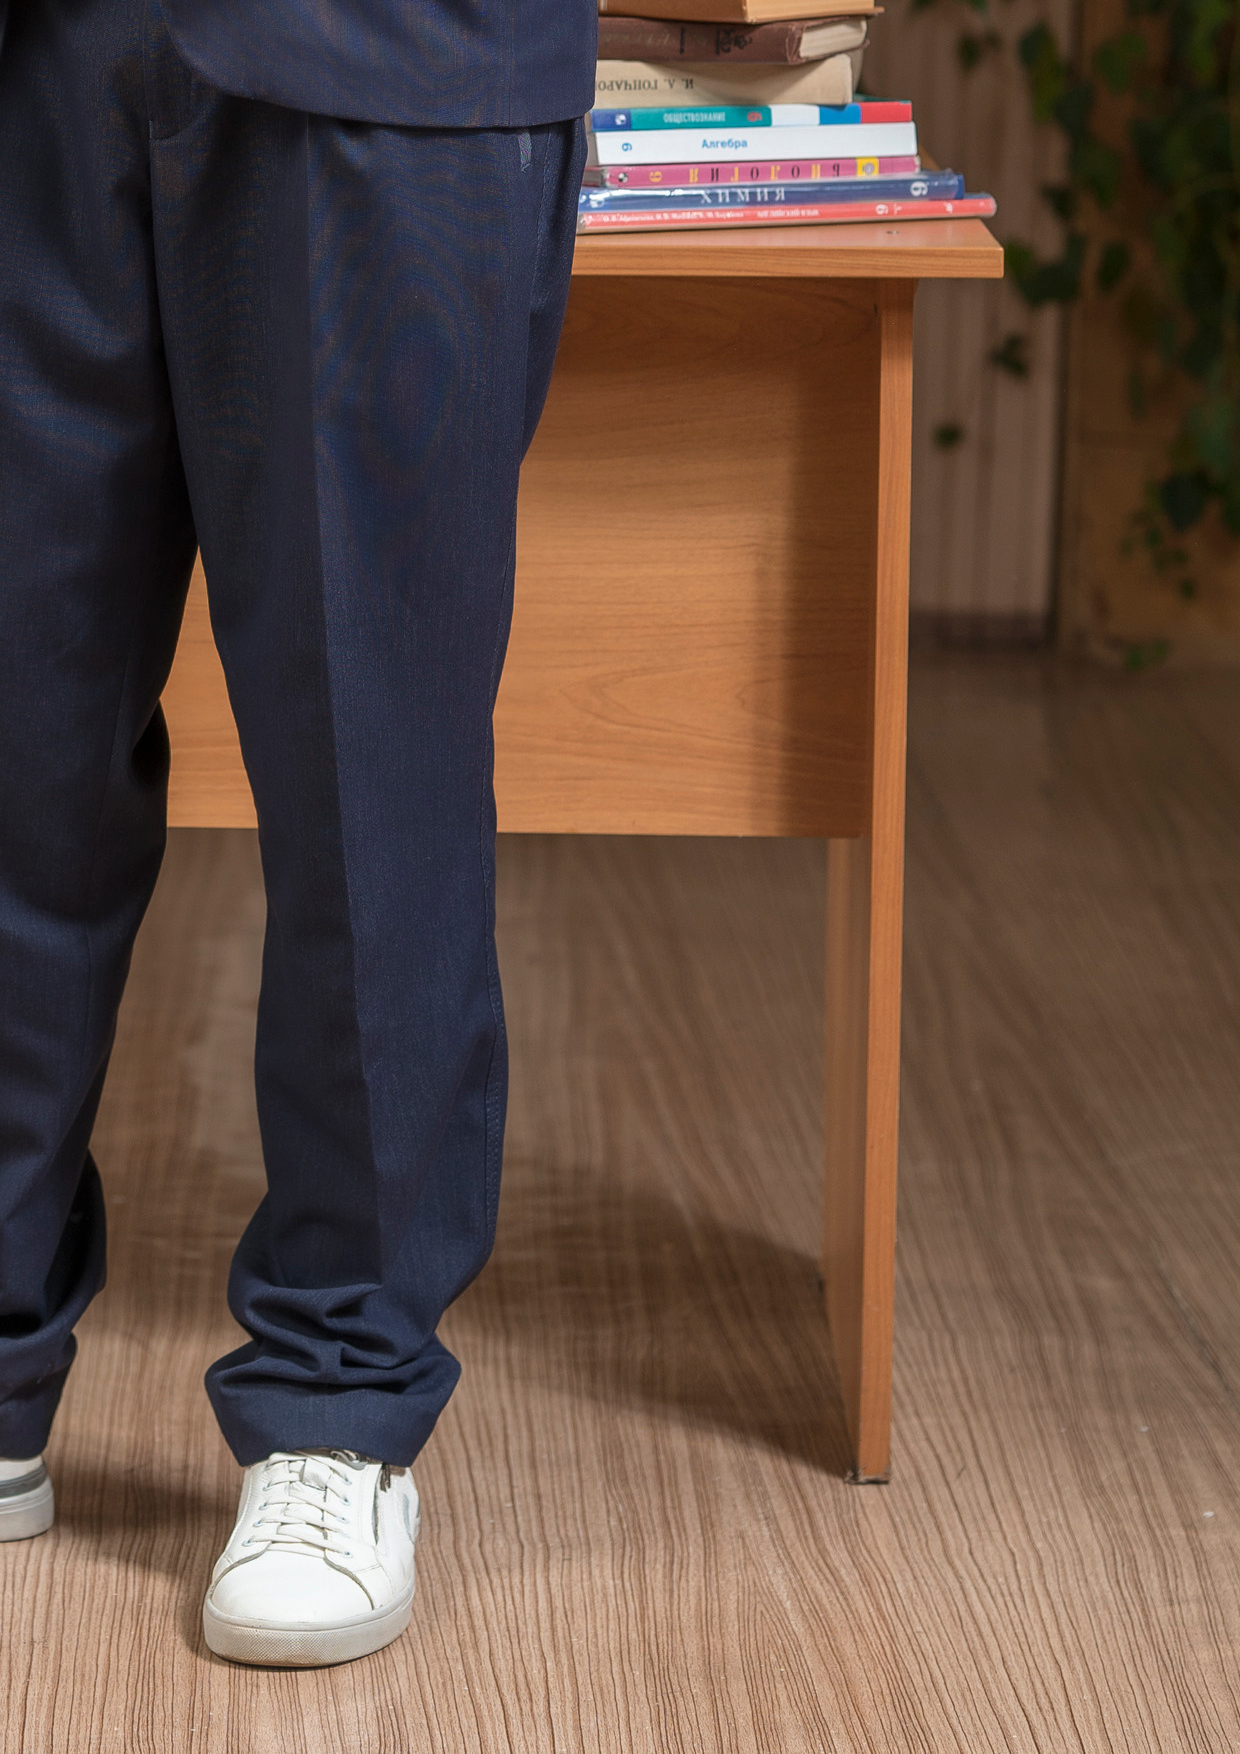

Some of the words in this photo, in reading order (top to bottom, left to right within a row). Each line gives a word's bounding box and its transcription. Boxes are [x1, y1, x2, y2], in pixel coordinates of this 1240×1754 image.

[701, 138, 748, 151] Алгебра
[689, 163, 840, 183] БИОЛОГИЯ
[700, 187, 786, 204] ХИМИЯ
